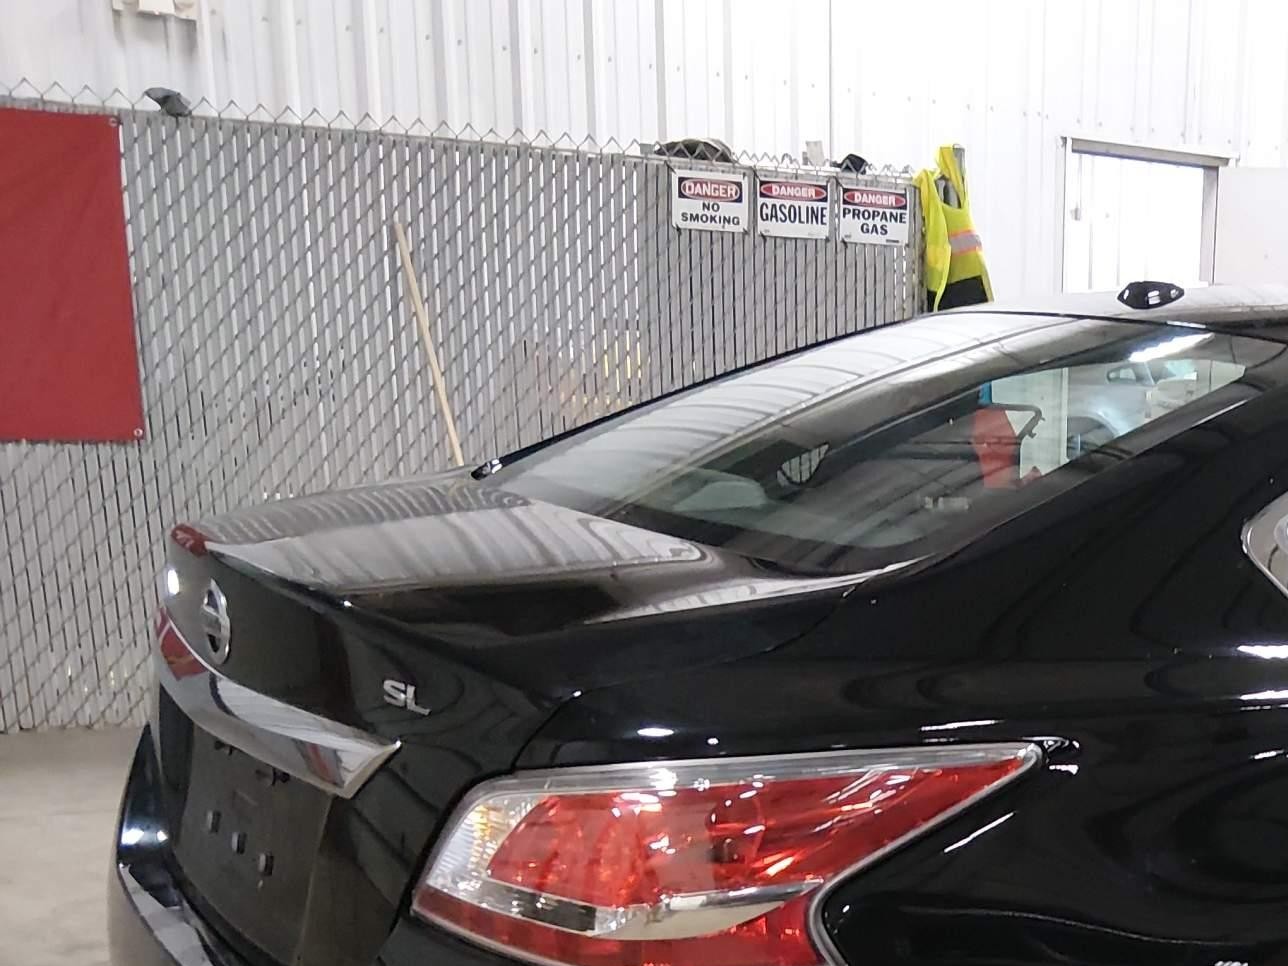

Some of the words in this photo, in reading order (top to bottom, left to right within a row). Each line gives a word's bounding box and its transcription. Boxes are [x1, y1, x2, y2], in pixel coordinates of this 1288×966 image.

[685, 181, 737, 198] DANGER
[771, 183, 816, 199] DANGER
[854, 191, 897, 206] DANGER
[702, 202, 720, 212] NO
[760, 202, 828, 225] GASOLINE
[681, 212, 740, 226] SMOKING
[842, 207, 907, 224] PROPANE
[860, 222, 888, 236] GAS
[383, 679, 431, 716] SL
